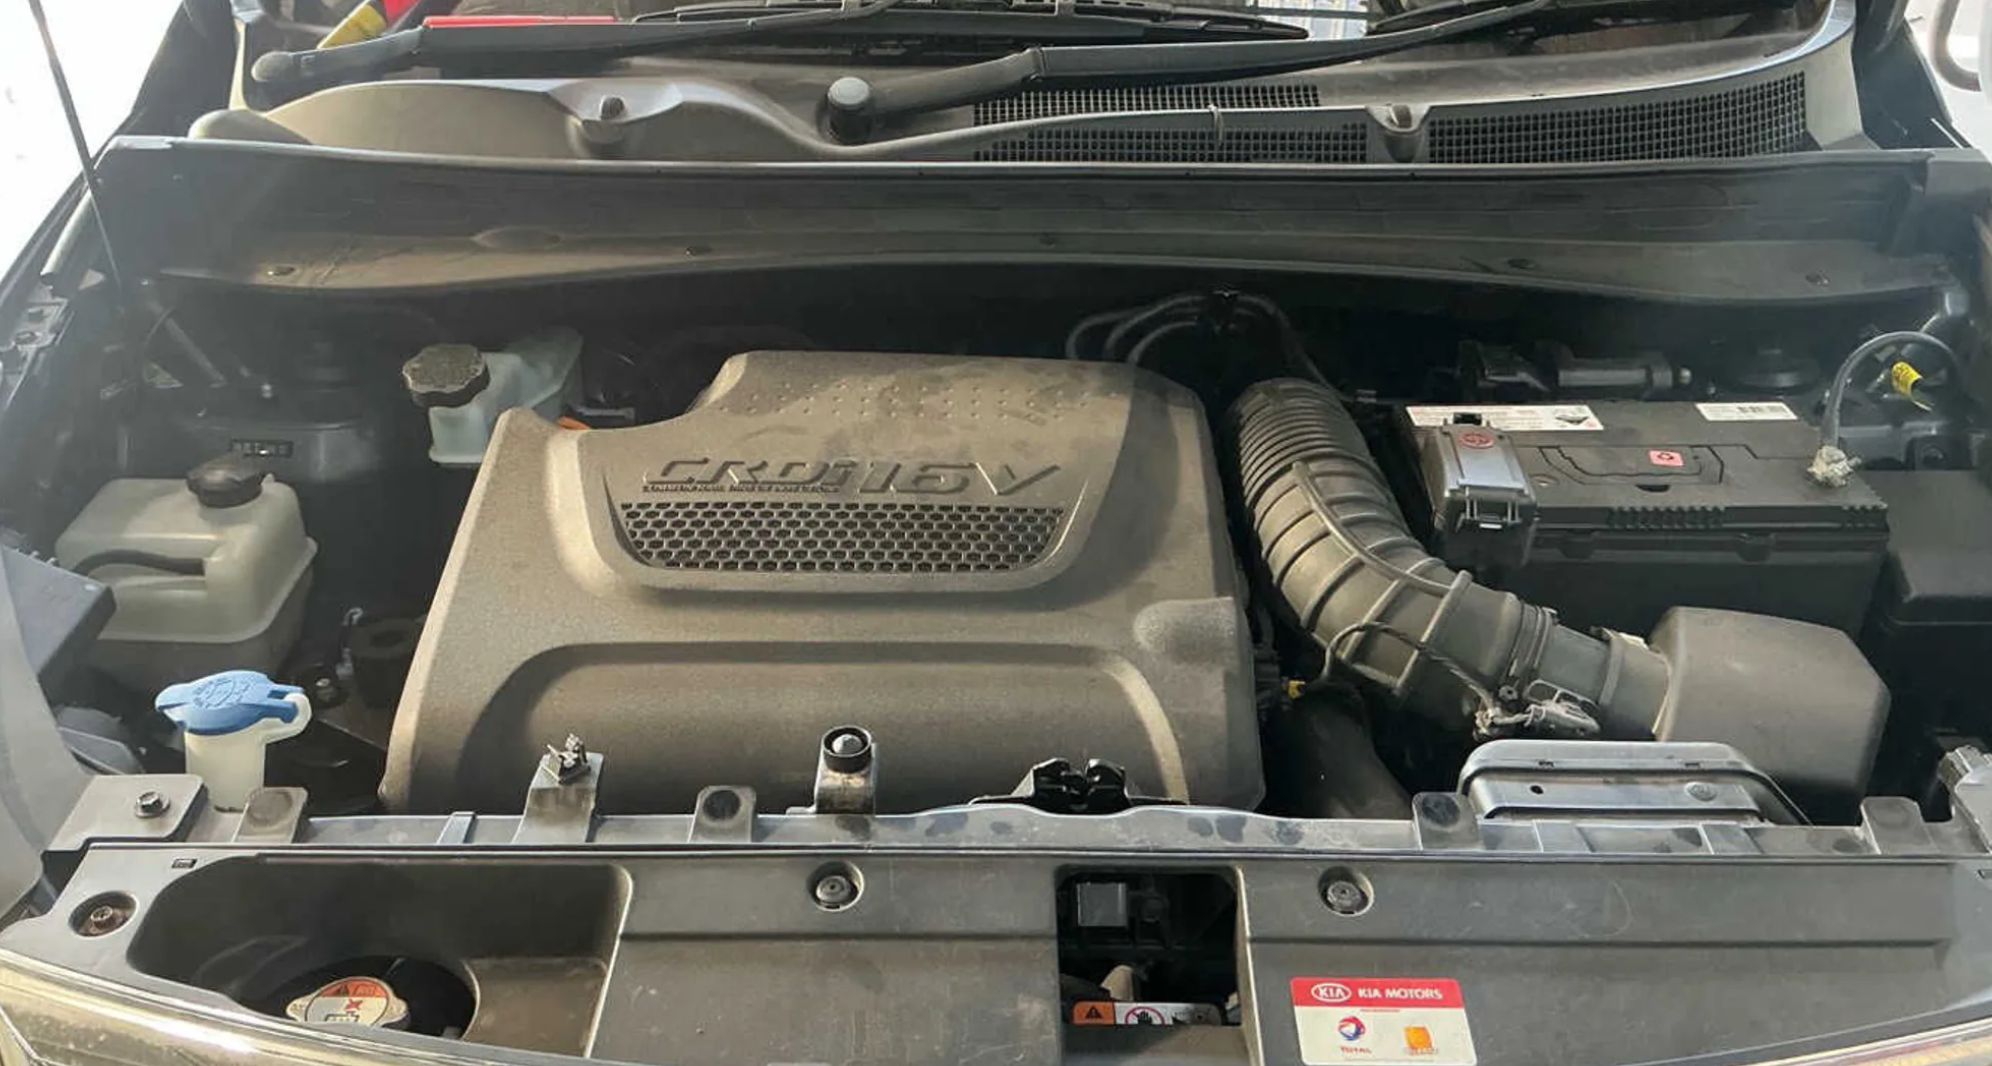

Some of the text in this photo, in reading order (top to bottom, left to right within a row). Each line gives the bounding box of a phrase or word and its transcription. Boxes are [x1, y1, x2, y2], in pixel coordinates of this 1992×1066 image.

[1319, 987, 1346, 999] KIA
[1358, 988, 1443, 1000] KIA MOTORS
